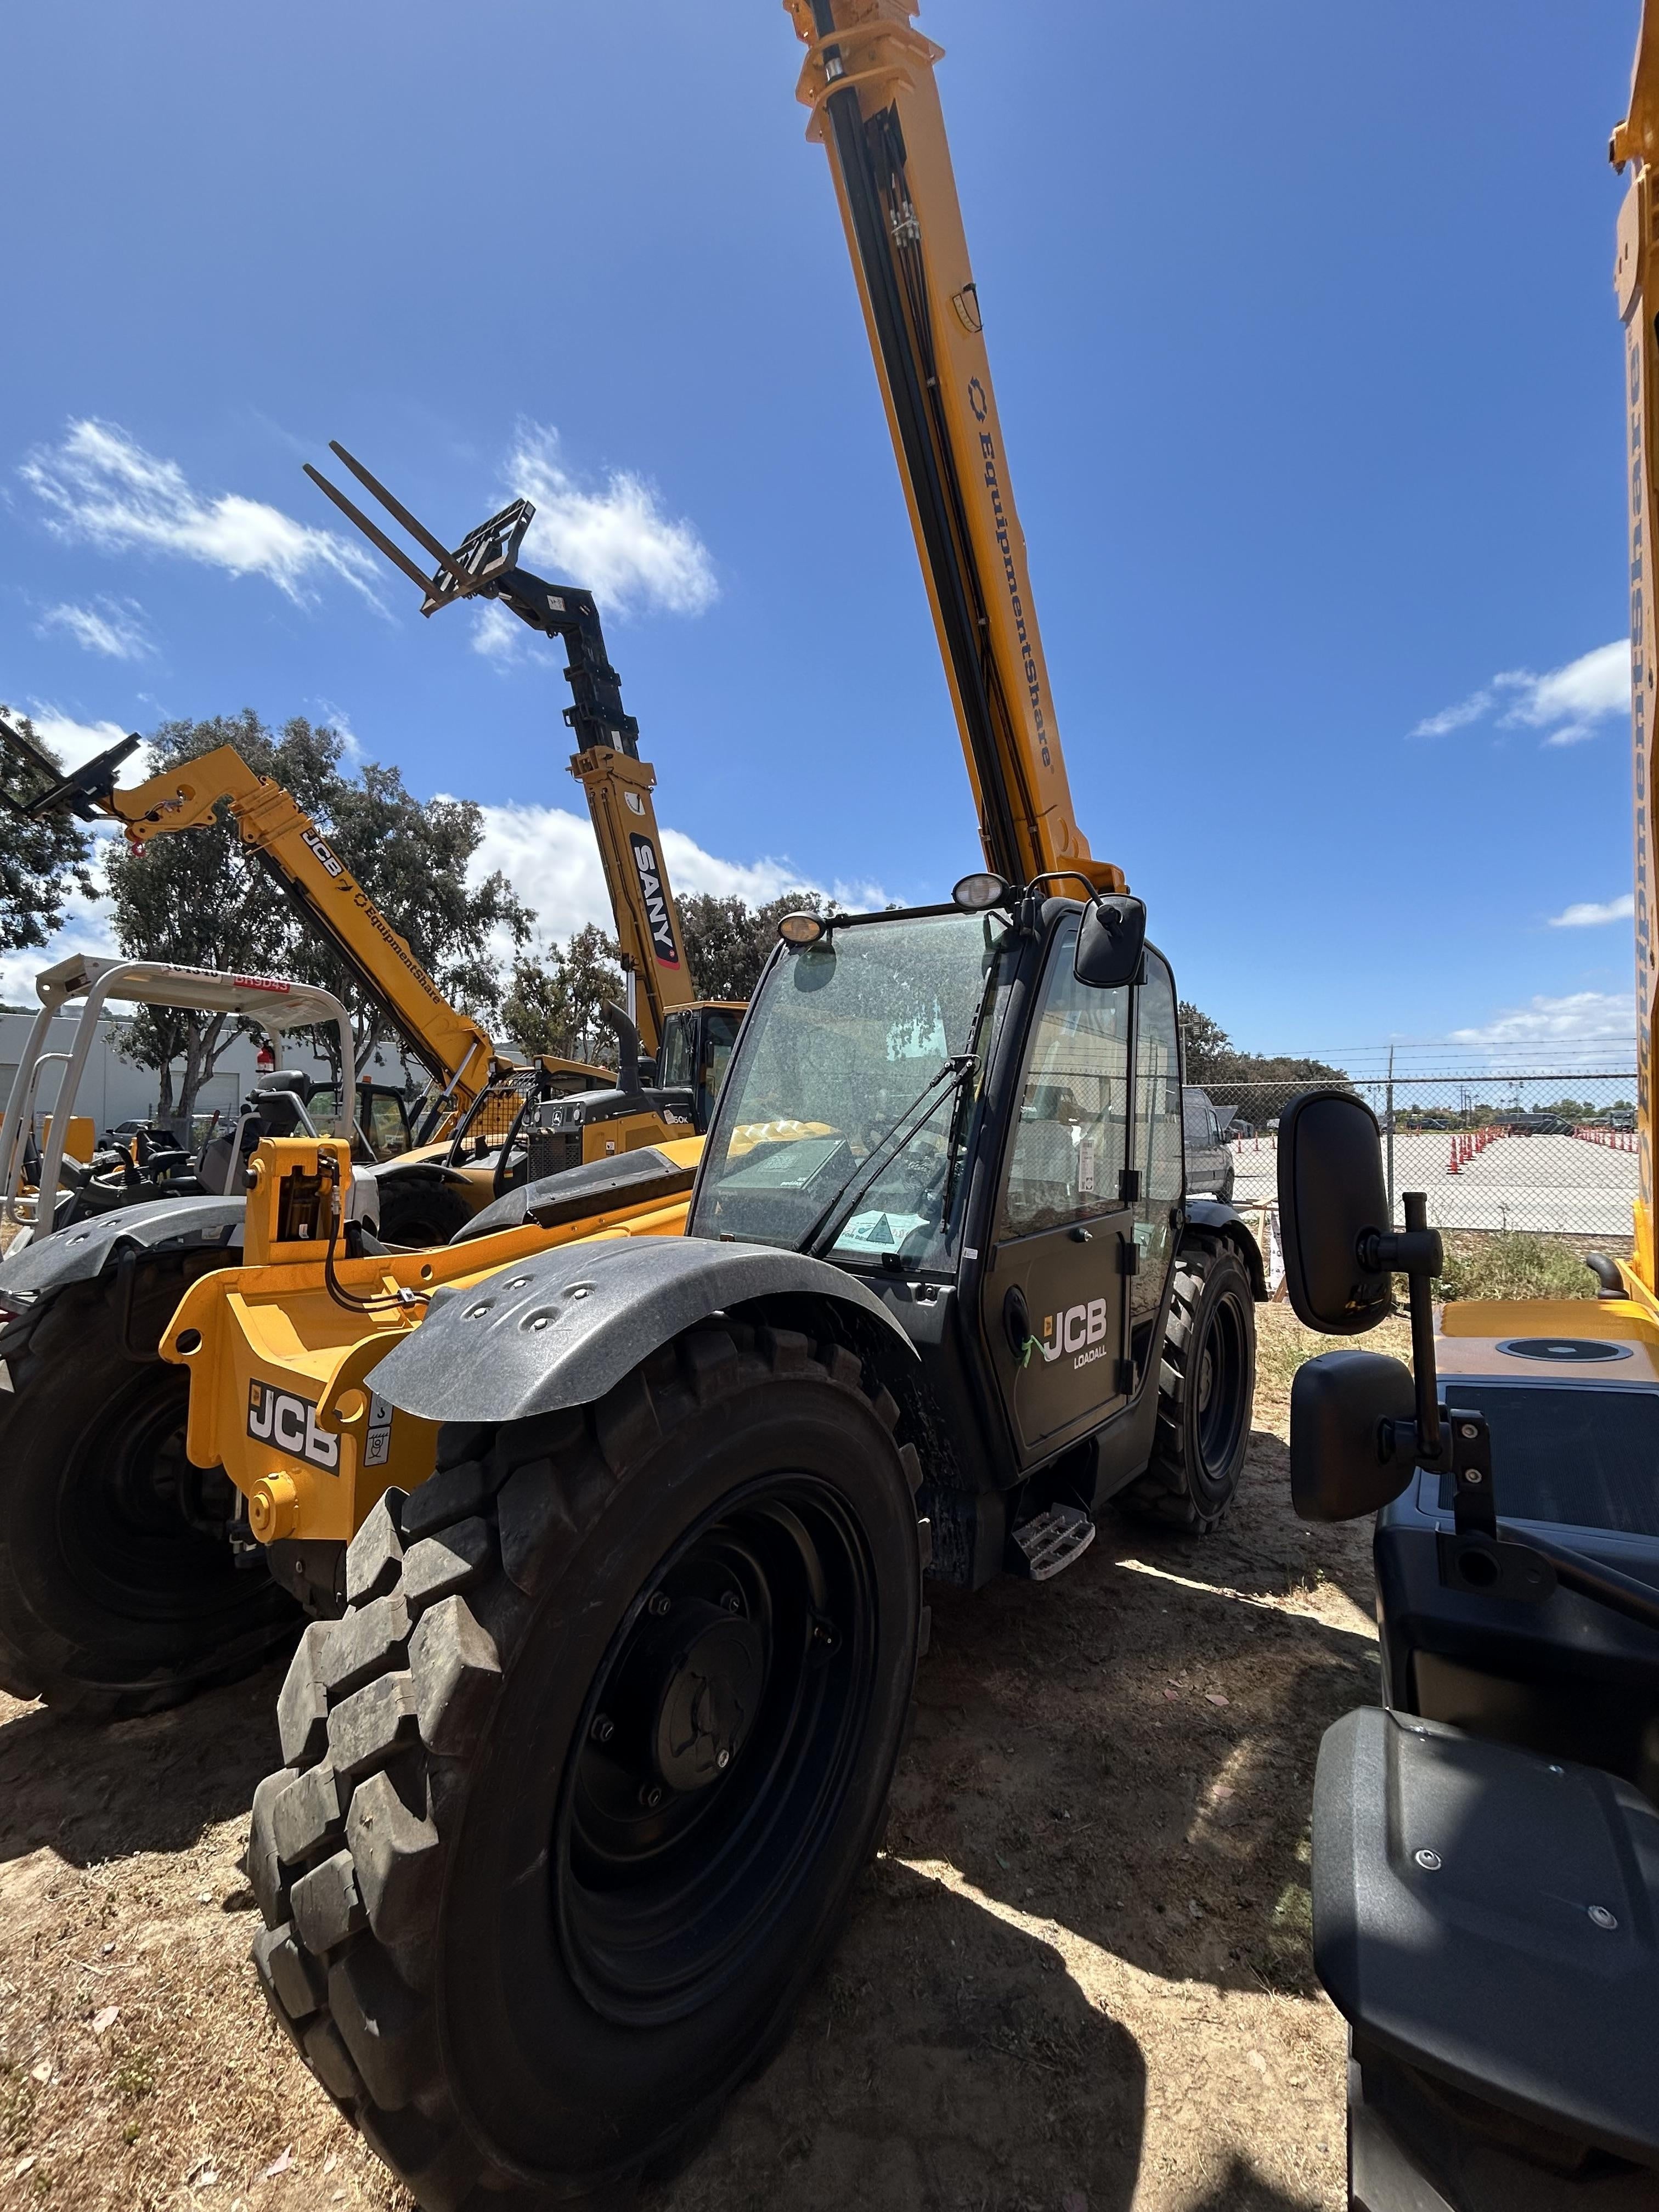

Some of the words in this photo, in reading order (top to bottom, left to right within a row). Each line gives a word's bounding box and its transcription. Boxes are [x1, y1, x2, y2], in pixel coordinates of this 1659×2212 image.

[979, 432, 1051, 768] EquipmentShare
[302, 832, 343, 877] JCB
[634, 845, 674, 948] SANY
[364, 905, 441, 1005] EquipmentShare
[1043, 1297, 1107, 1362] JCB
[1074, 1345, 1107, 1369] LOADALL
[250, 1389, 338, 1467] JCB
